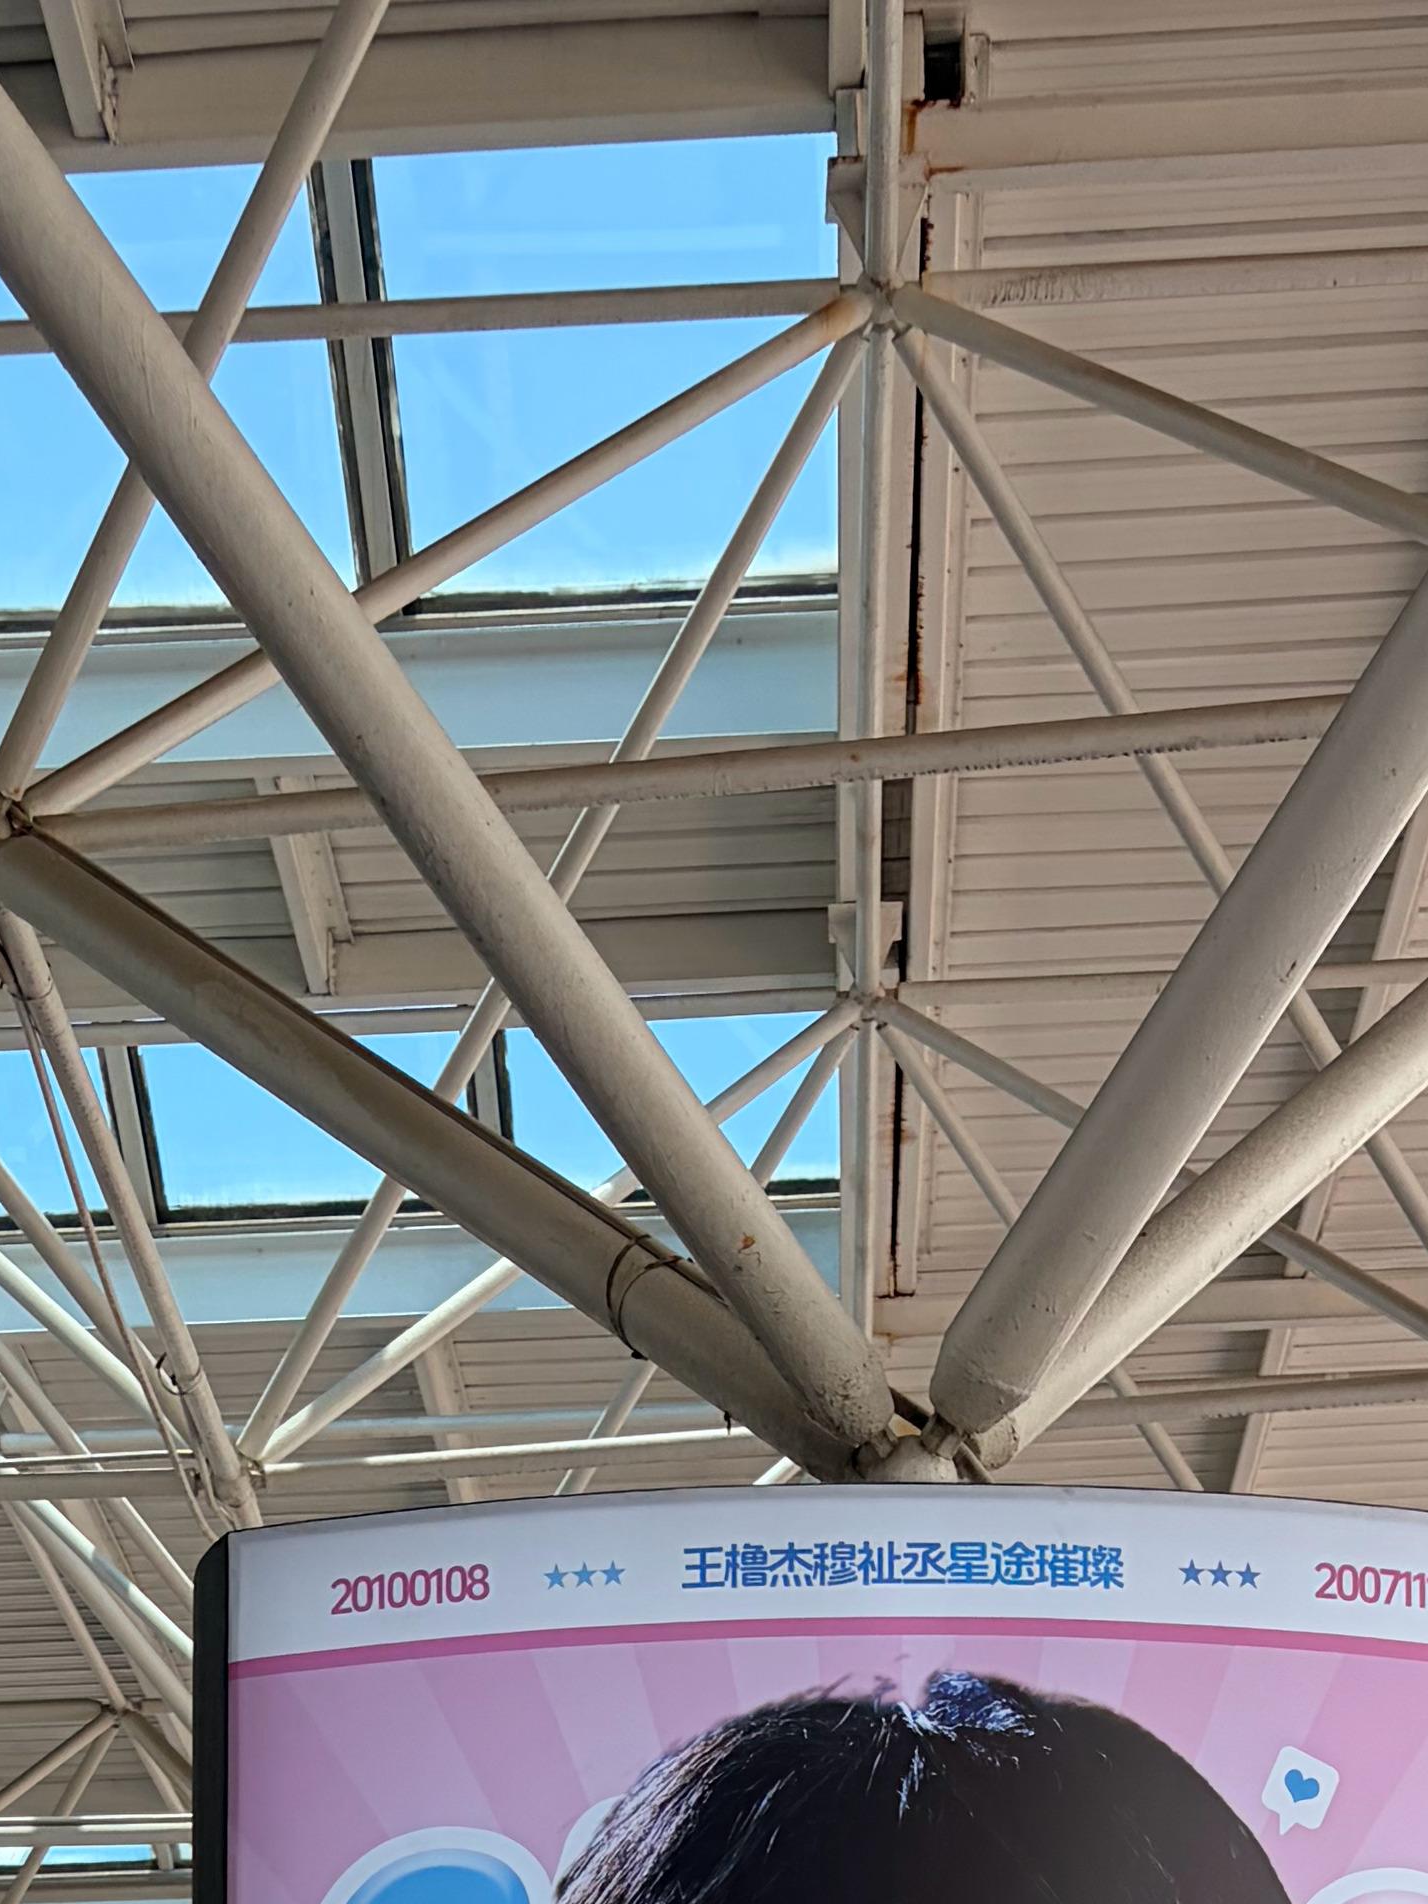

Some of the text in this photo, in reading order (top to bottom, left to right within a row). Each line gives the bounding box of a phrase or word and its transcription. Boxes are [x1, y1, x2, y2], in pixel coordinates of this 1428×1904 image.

[330, 1562, 491, 1616] 20100108
[681, 1541, 1125, 1590] 王橹杰穆祉丞星途璀璨
